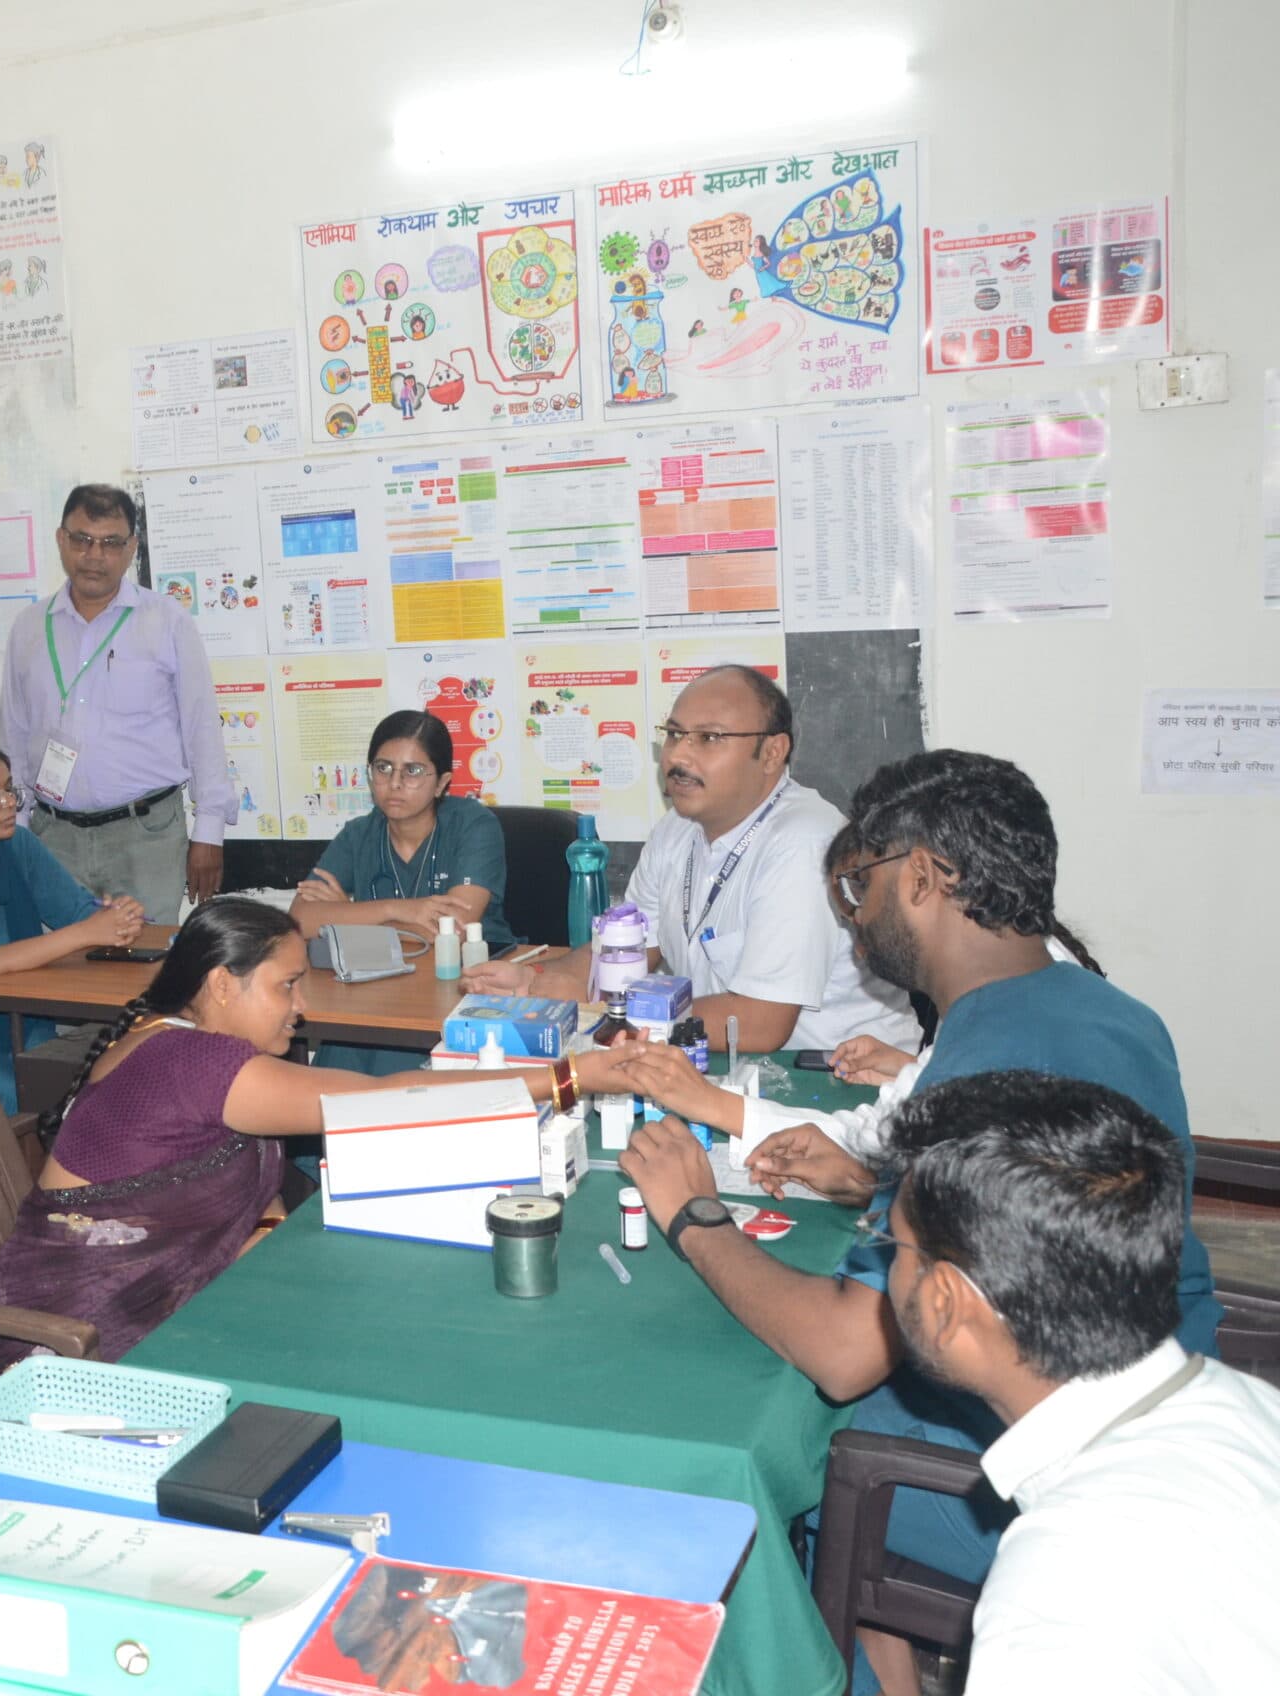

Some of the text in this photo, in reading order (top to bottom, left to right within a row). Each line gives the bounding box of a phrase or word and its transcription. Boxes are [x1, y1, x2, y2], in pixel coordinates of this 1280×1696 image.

[598, 149, 899, 207] मासिक धर्म स्वच्छता और देखभाल
[304, 196, 560, 248] एनीमिया रोकथाम और उपचार
[1158, 716, 1179, 727] आप
[1213, 714, 1224, 728] ही
[1231, 717, 1260, 730] चुनाव
[1162, 760, 1275, 773] छोटा परिवार सुखी परिवार
[534, 1615, 583, 1690] ROADMAP TO
[557, 1662, 587, 1696] ASLES
[580, 1600, 618, 1650] RUBELLA
[583, 1615, 636, 1696] IMINATION IN
[611, 1625, 661, 1696] NDIA BY 2023
